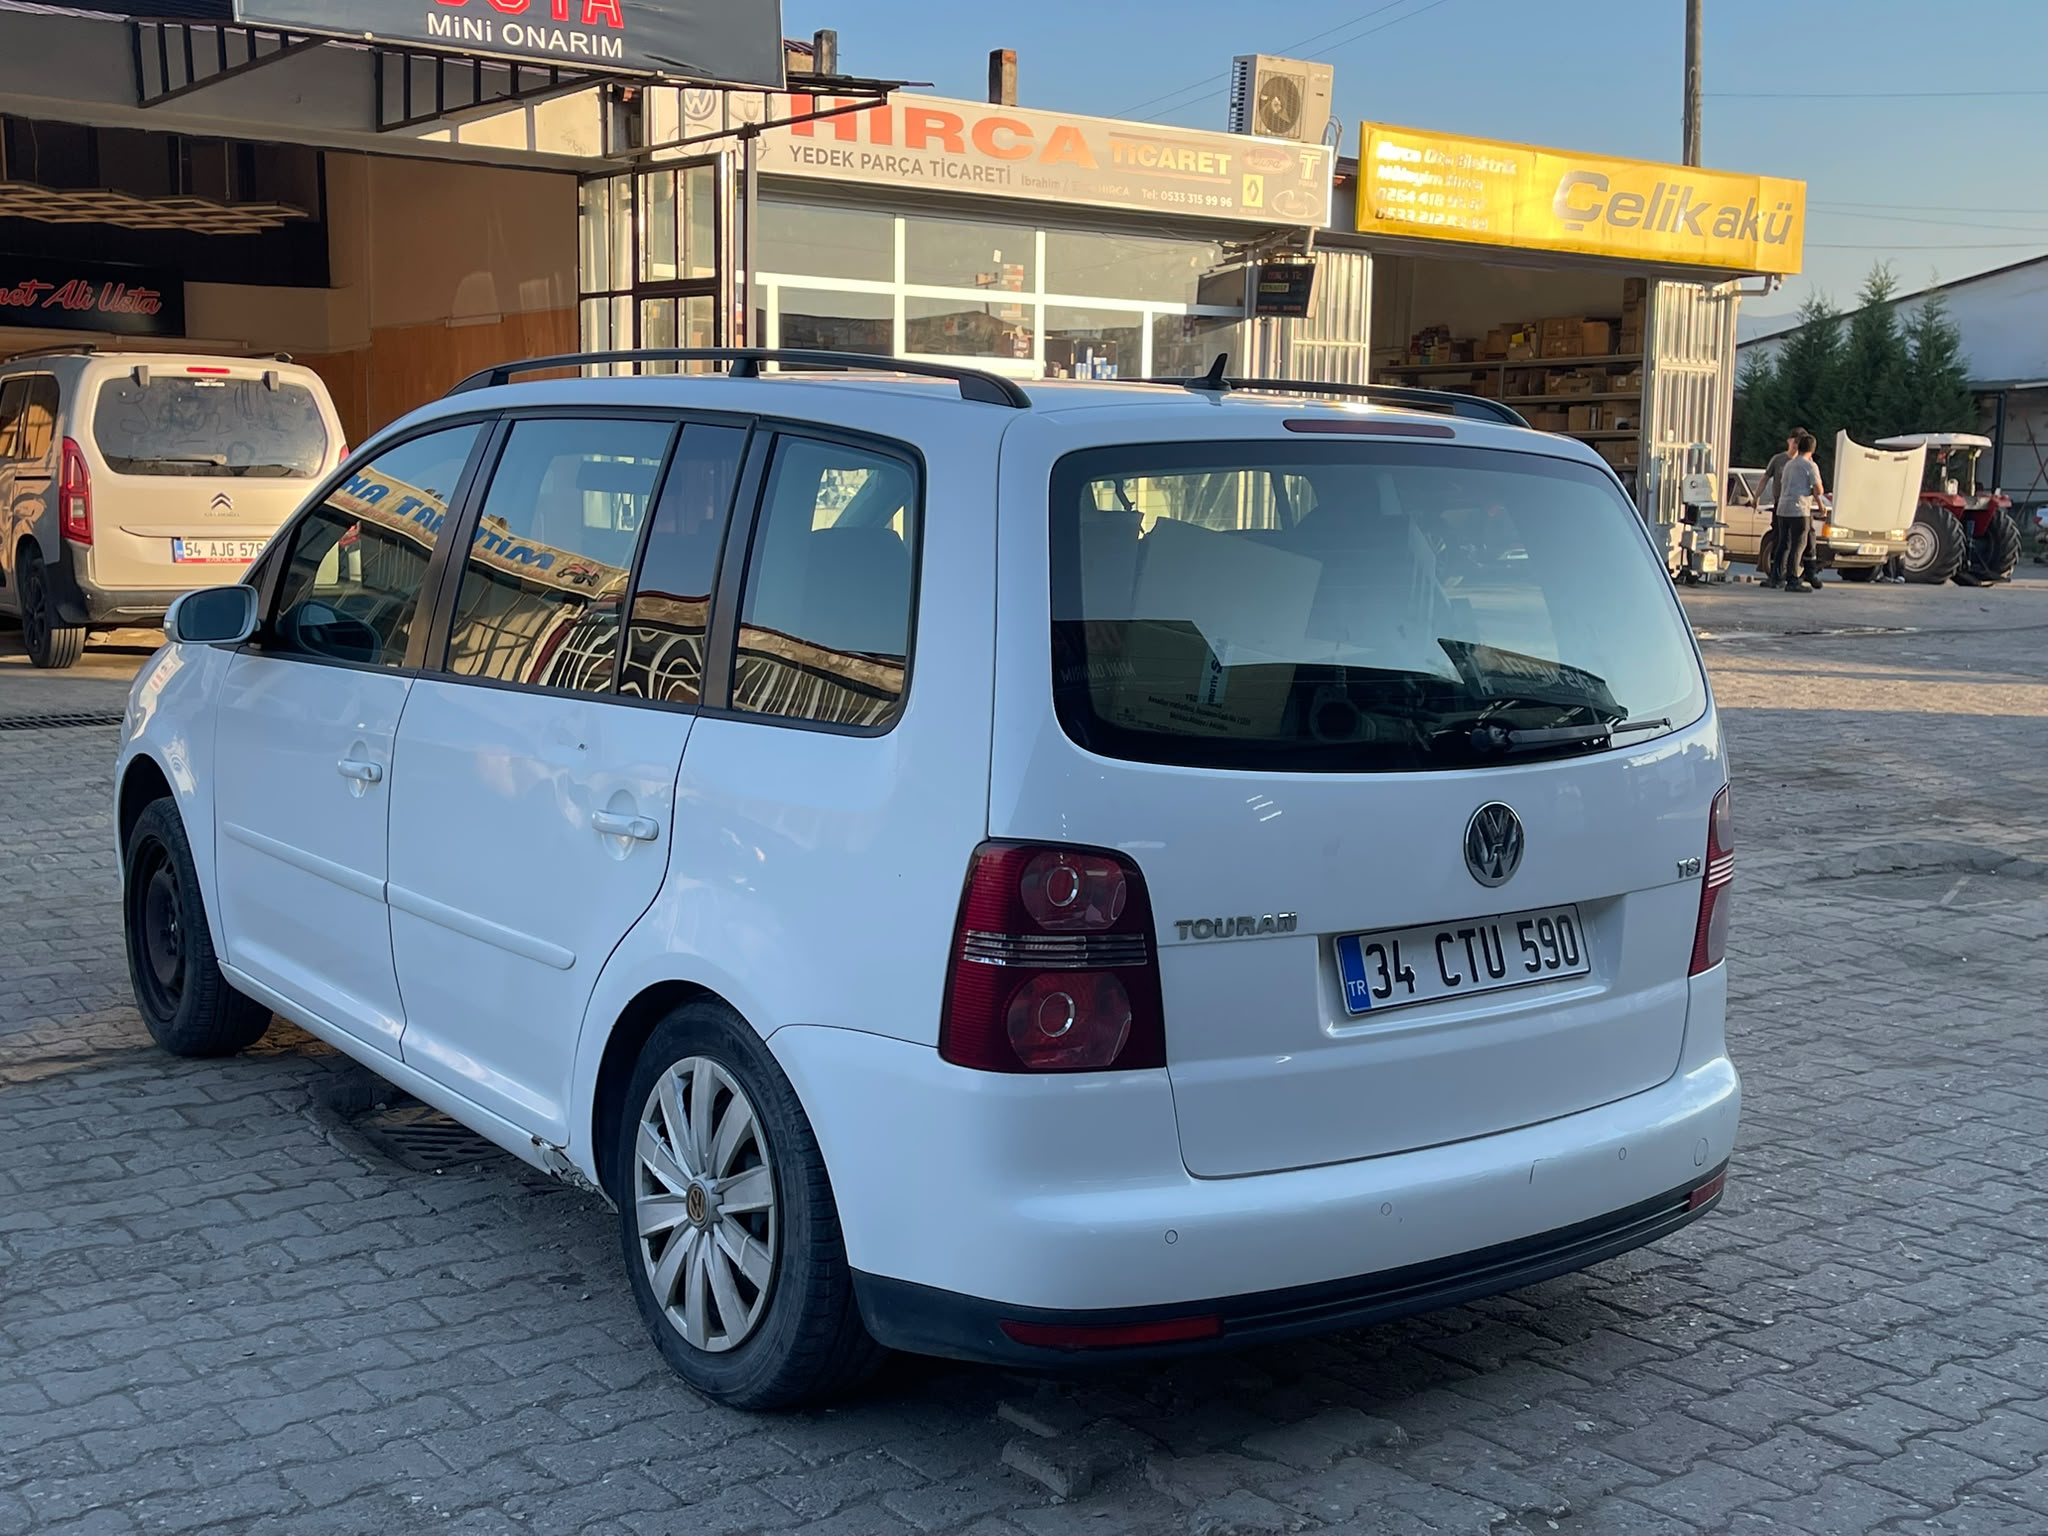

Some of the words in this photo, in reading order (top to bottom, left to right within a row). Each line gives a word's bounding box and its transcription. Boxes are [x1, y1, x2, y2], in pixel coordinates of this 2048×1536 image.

[502, 23, 623, 59] ONARIM
[790, 93, 1098, 169] HIRCA
[789, 144, 854, 168] YEDEK
[861, 153, 924, 177] PARÇA
[929, 158, 1011, 184] TİCARETİ
[1141, 189, 1158, 200] Tel:
[1160, 191, 1185, 203] 0533
[1187, 193, 1203, 204] 315
[1205, 195, 1218, 206] 99
[1220, 197, 1232, 207] 96
[1552, 170, 1712, 236] Çelik
[1712, 197, 1793, 245] akü
[41, 279, 95, 310] Ali
[98, 281, 162, 315] Usta
[185, 542, 201, 556] 54
[210, 542, 234, 556] AJG
[1174, 912, 1297, 940] TOURAN
[1348, 979, 1367, 996] TR
[1365, 942, 1416, 1000] 34
[1435, 924, 1506, 986] CTU
[1516, 914, 1580, 972] 590
